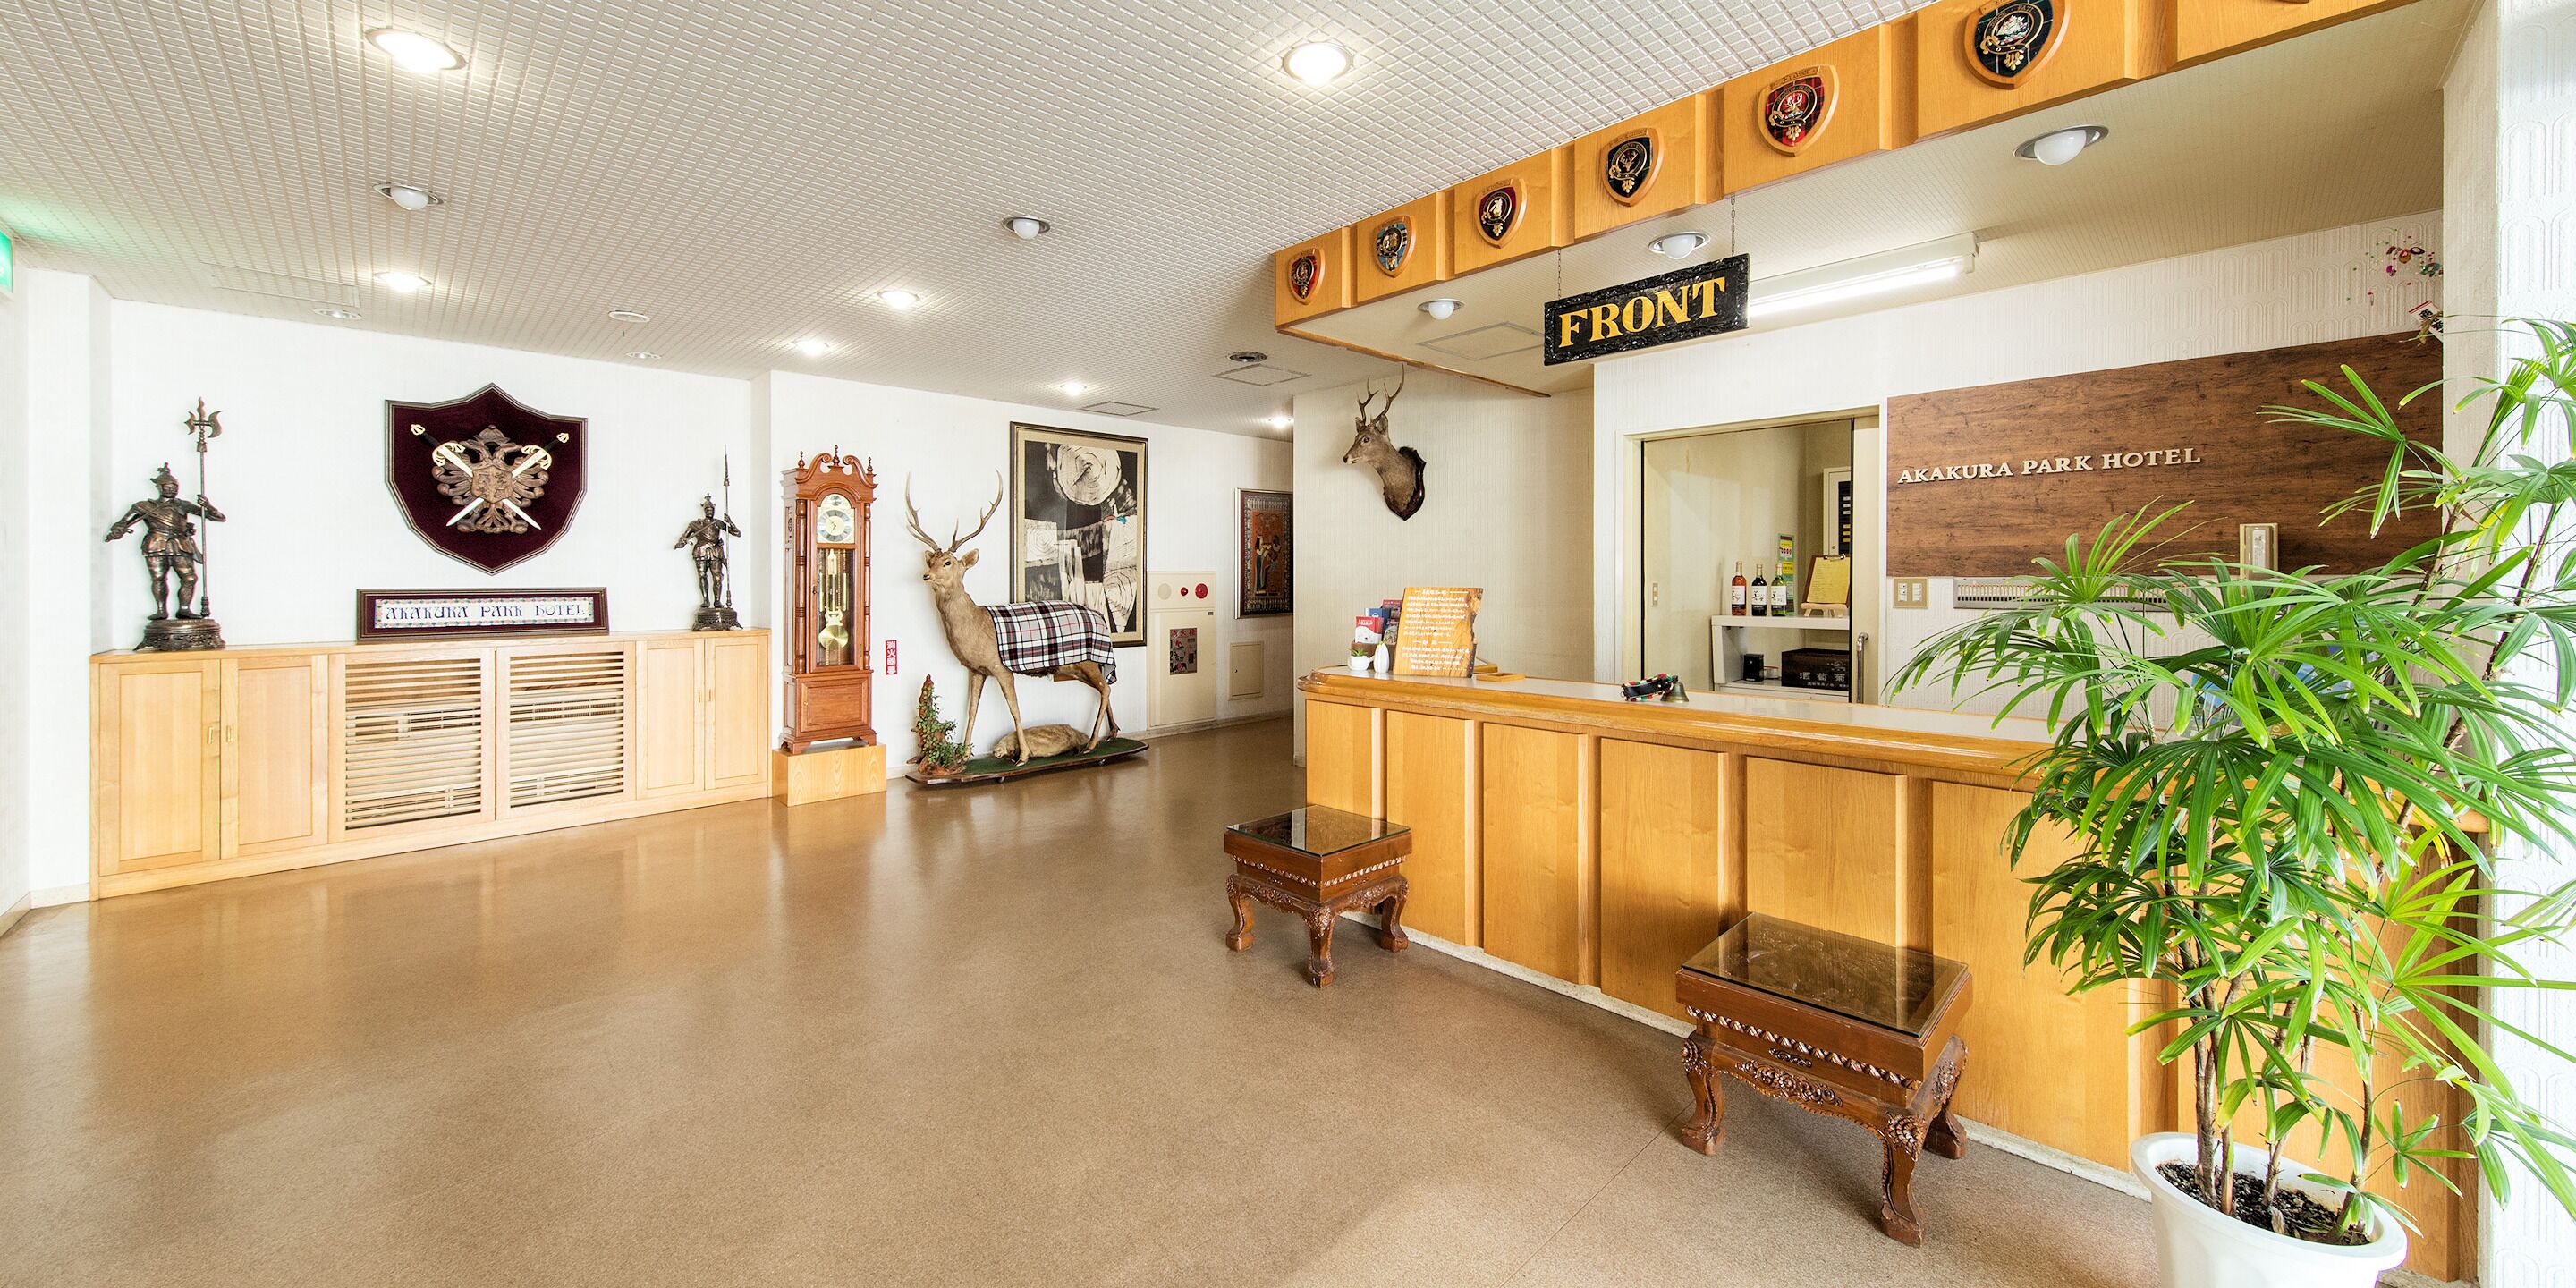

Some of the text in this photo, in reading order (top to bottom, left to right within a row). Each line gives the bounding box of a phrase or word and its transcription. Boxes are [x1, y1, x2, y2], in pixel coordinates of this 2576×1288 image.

[1558, 276, 1726, 349] FRONT
[1897, 447, 2202, 485] AKAKURA PARK HOTEL
[385, 603, 586, 620] AKAKURA PARK HOTEL
